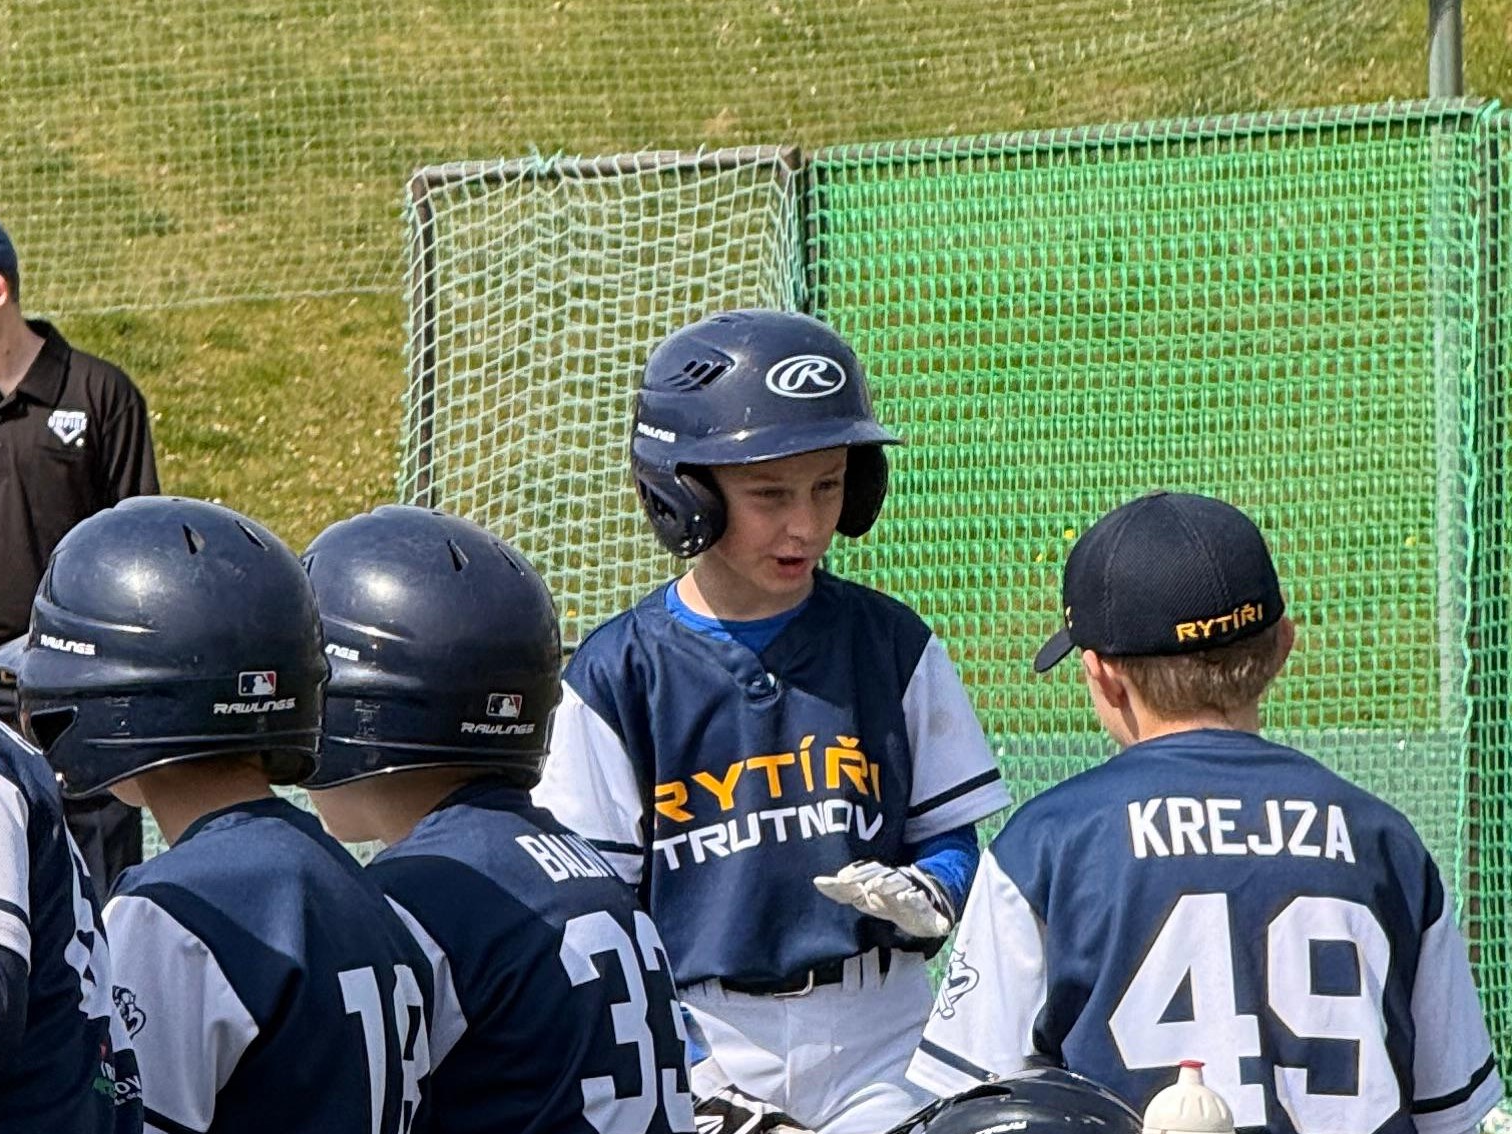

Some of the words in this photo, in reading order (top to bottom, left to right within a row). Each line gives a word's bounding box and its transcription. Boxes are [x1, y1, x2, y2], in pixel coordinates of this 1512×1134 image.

[1175, 602, 1264, 643] RYTÍŘI
[40, 634, 96, 656] RAWLINGS
[212, 697, 297, 715] RAWLINGS
[460, 721, 536, 735] RAWLINGS
[654, 734, 880, 813] RYTÍŘI
[652, 798, 884, 871] TRUTNOV
[1127, 797, 1357, 864] KREJZA
